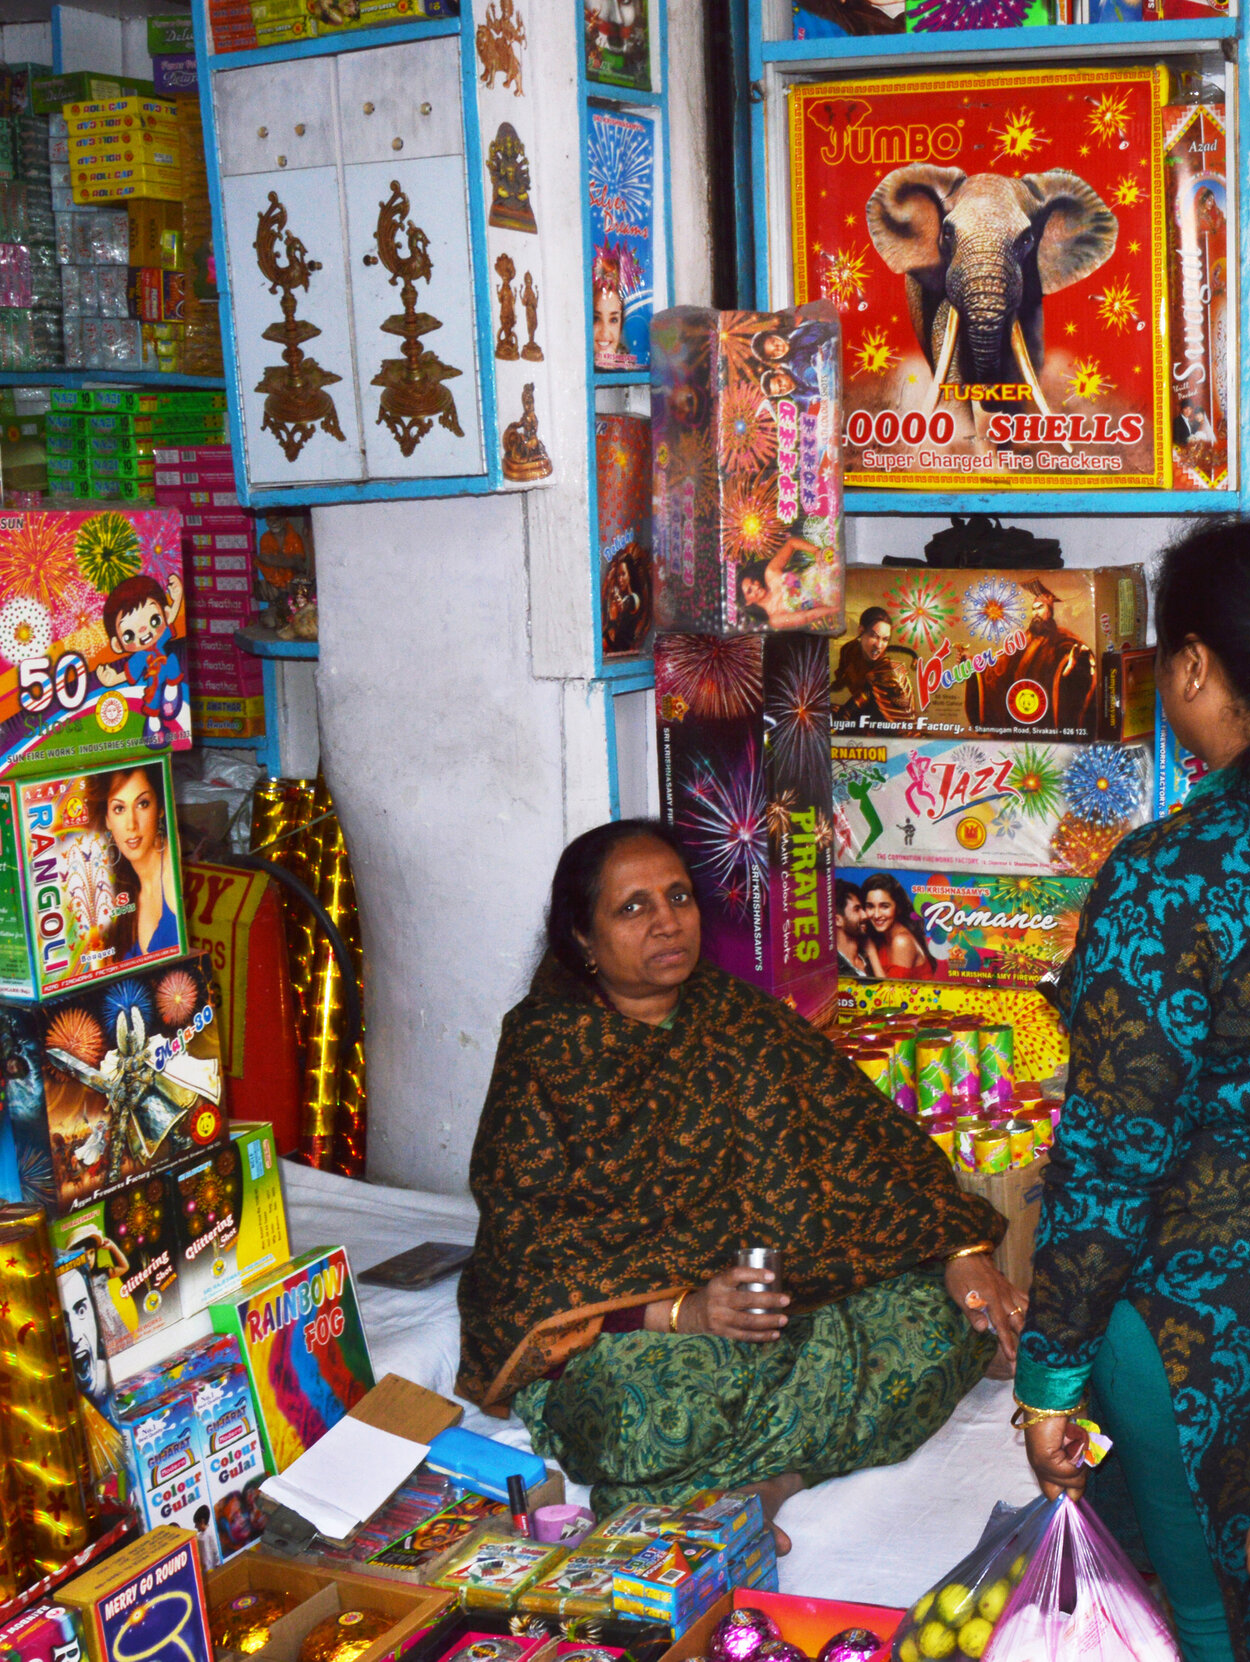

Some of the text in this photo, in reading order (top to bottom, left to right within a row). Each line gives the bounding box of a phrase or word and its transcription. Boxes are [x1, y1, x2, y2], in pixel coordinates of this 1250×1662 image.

[166, 29, 195, 42] Delu
[83, 101, 128, 113] ROLL CAP
[820, 124, 963, 166] JUMBO
[1188, 139, 1217, 153] Azad
[90, 170, 134, 181] ROLL CAP
[92, 186, 135, 198] ROLL CAP
[588, 181, 627, 212] Silver
[604, 210, 648, 239] Dreams
[1173, 247, 1212, 385] Swagat
[820, 375, 829, 397] SHOTS
[939, 383, 1035, 401] TUSKER
[841, 410, 1144, 447] 0000 SHELLS
[777, 400, 799, 524] SPEED
[863, 451, 1122, 473] Super Charged Fire Crackers
[0, 517, 24, 530] SUN
[726, 560, 738, 624] SUPREME
[19, 652, 88, 713] 50
[917, 630, 1027, 712] Power-60
[24, 715, 83, 738] Shots
[830, 713, 856, 731] yyan
[859, 715, 913, 730] Fireworks
[916, 716, 964, 734] Factory,
[975, 726, 1012, 735] Shanmugam
[1032, 727, 1058, 735] Sivakasi
[7, 754, 25, 764] SUN
[27, 752, 45, 761] FIRE
[47, 749, 76, 758] WORKS
[79, 741, 125, 755] INDUSTRIES
[830, 746, 887, 763] RNATION
[663, 727, 674, 827] SRI KRISHNASAMY FIR
[926, 757, 1024, 820] JAZZ
[923, 855, 953, 864] FIREWORKS
[28, 803, 69, 973] RANGOLI
[116, 892, 129, 906] 8
[186, 874, 234, 925] RY
[780, 832, 791, 965] Multi Colour Shots
[789, 806, 821, 963] PIRATES
[912, 885, 990, 897] SRI KRISHNASAMY'S
[111, 904, 136, 918] SHOTS
[750, 864, 763, 972] SRI KRISHNASAMY'S
[924, 902, 1058, 932] Romance
[80, 947, 116, 964] Bouquet
[961, 971, 1011, 980] KRISHNAAMY
[93, 1182, 124, 1199] Fireworks
[185, 1214, 234, 1261] Glittering
[219, 1228, 238, 1248] Shot
[119, 1250, 170, 1298] Glittering
[154, 1265, 173, 1286] Shot
[247, 1261, 345, 1344] RAINBOW
[304, 1306, 345, 1354] FOG
[206, 1405, 247, 1434] GUJARAT
[218, 1425, 243, 1445] Modern
[148, 1437, 191, 1469] GUJARAT
[160, 1457, 187, 1478] Modern
[210, 1440, 257, 1473] Colour
[218, 1454, 256, 1484] Gulal
[152, 1471, 202, 1508] Colour
[160, 1486, 201, 1518] Gulal
[105, 1584, 138, 1621] MERRY
[139, 1576, 153, 1596] GO
[155, 1550, 188, 1584] ROUND
[7, 1605, 51, 1635] RAINBOW
